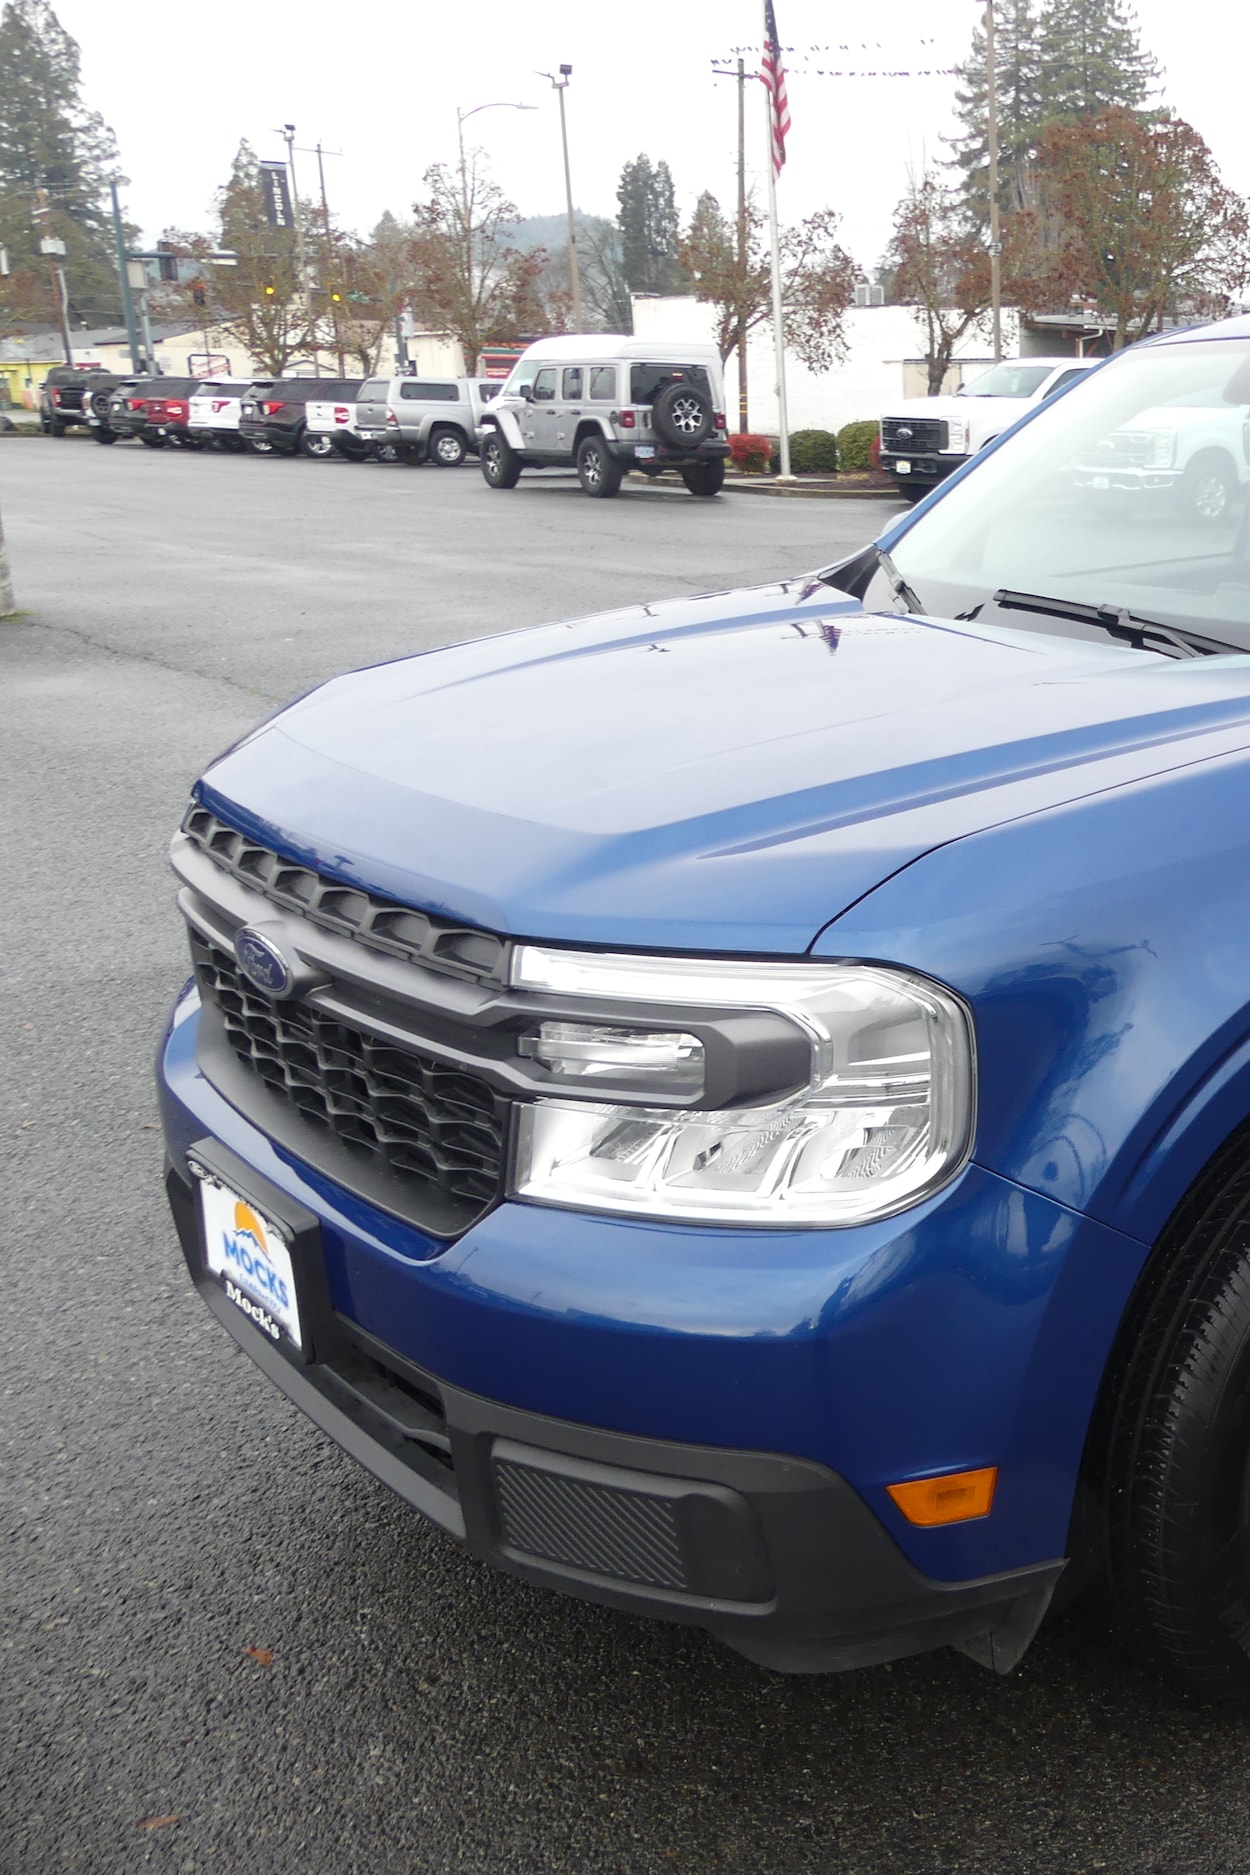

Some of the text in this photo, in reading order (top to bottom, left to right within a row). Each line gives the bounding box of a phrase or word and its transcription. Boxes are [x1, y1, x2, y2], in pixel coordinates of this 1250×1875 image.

[271, 171, 286, 227] LINCOLN
[222, 1230, 290, 1309] MOCKS
[225, 1279, 281, 1341] Mock's
